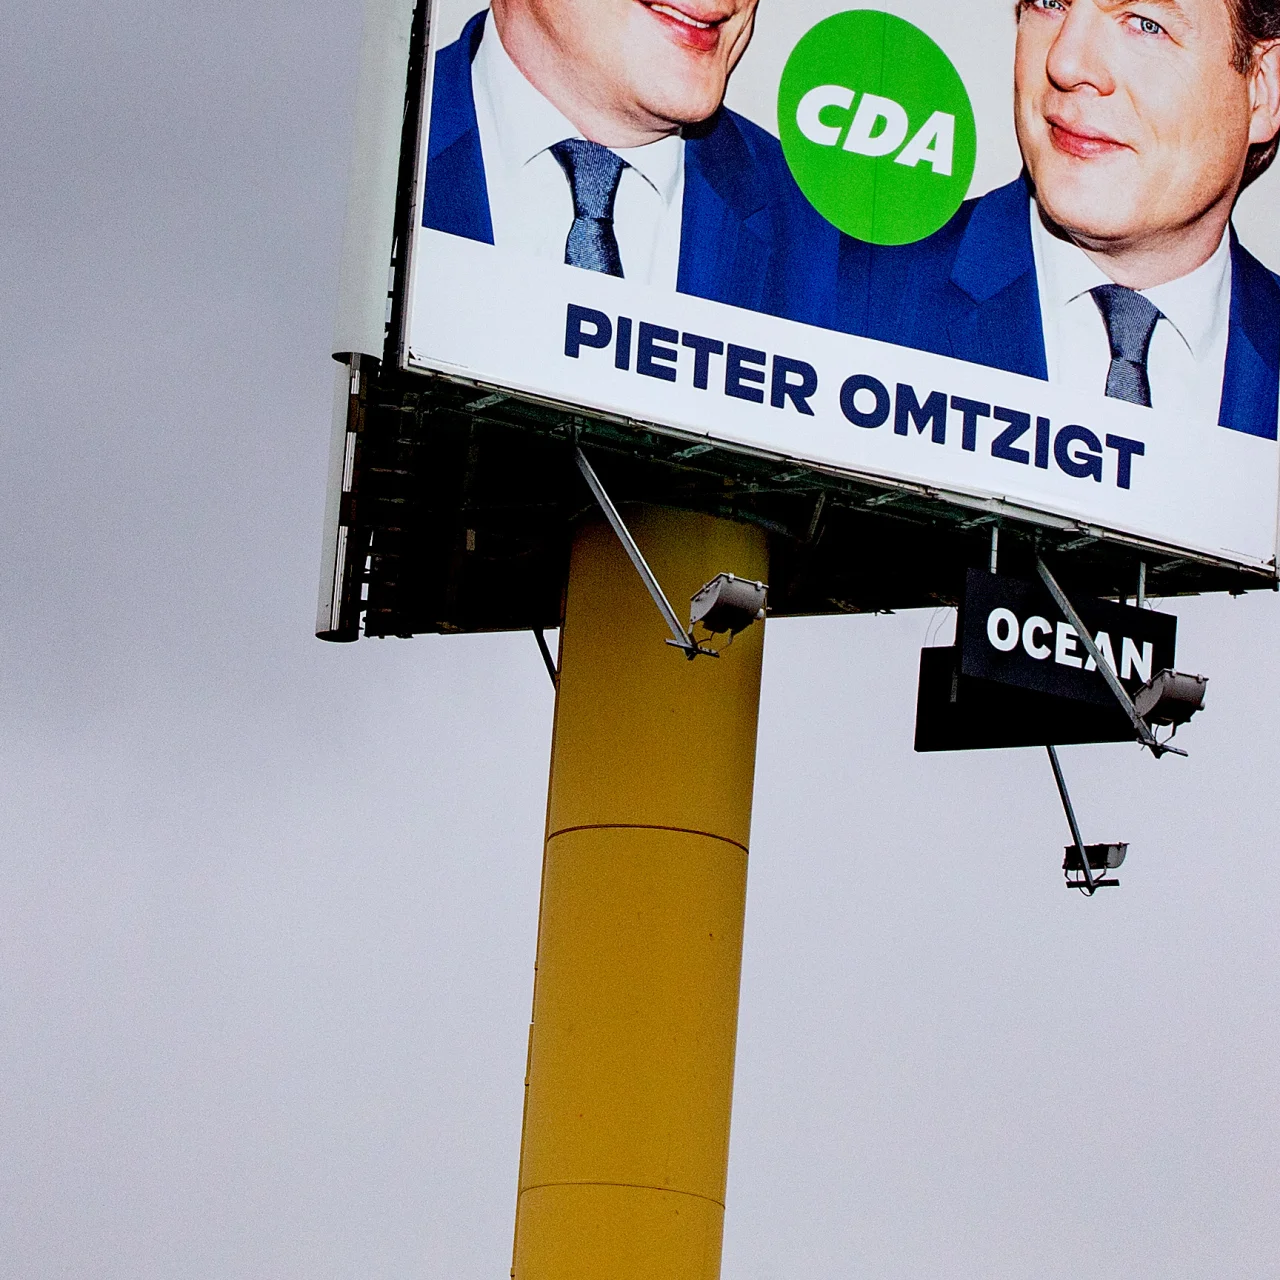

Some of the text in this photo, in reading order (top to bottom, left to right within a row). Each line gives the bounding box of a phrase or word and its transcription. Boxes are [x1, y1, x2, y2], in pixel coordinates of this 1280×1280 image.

[795, 84, 956, 176] CDA
[564, 303, 1145, 490] PIETER OMTZIGT
[987, 607, 1153, 685] OCEAN
